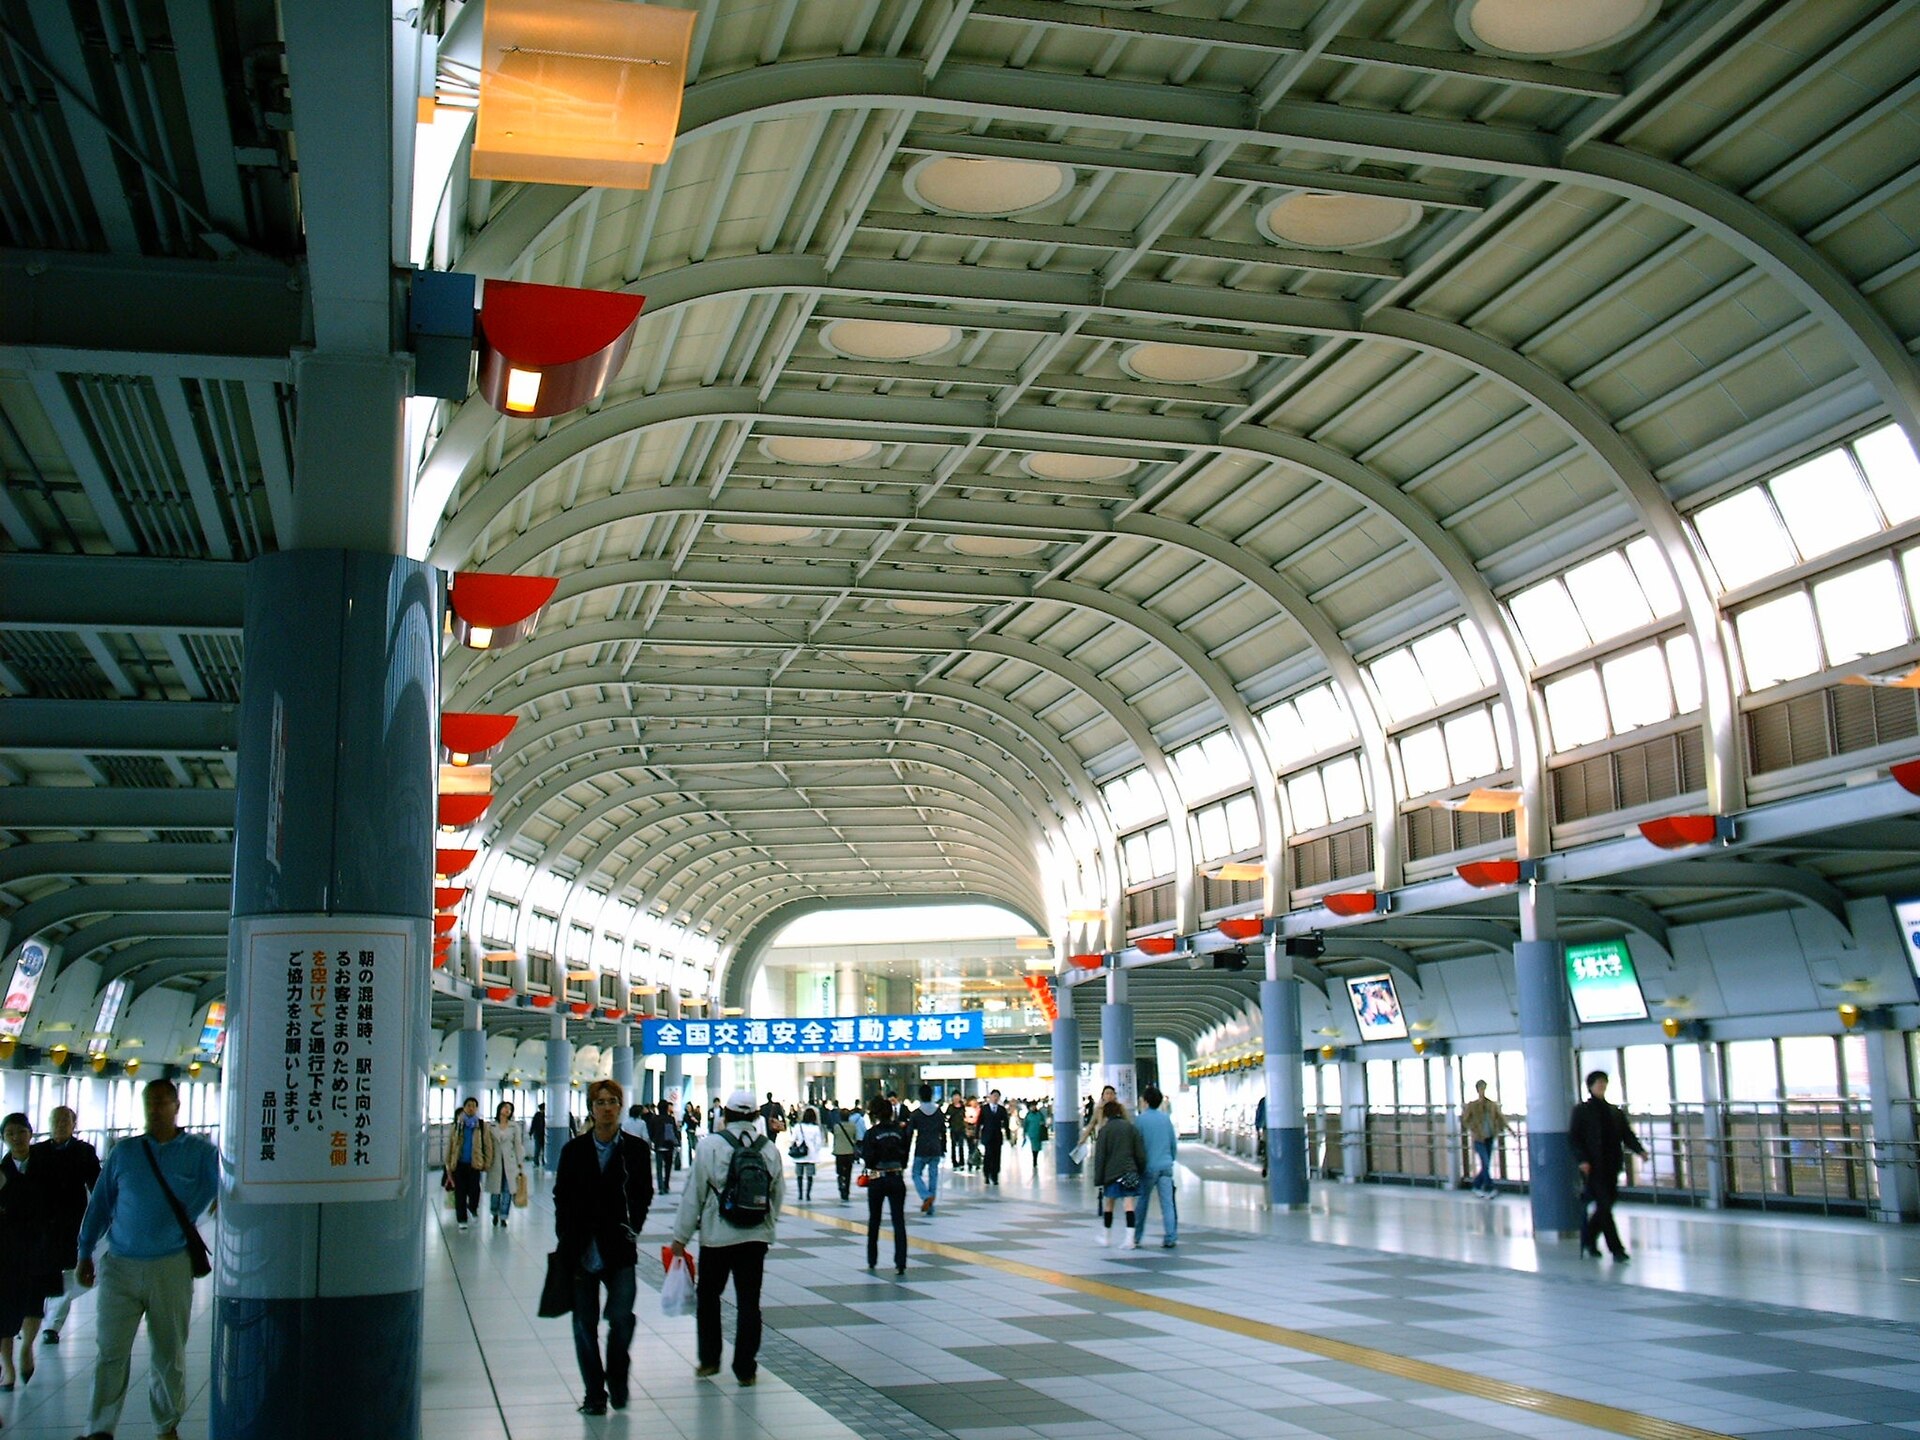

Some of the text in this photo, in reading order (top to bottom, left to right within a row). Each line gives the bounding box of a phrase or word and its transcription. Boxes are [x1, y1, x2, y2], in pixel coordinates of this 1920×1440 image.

[283, 949, 304, 1132] ご協力をお願いします。
[307, 949, 328, 1132] を空けてご通行下さい。
[330, 950, 351, 1167] るお客さまのために、左側
[354, 949, 375, 1166] 朝の混雑時、駅に向かわれ
[656, 1015, 970, 1046] 全国交通安全運動実施中
[260, 1090, 277, 1161] 品川駅長
